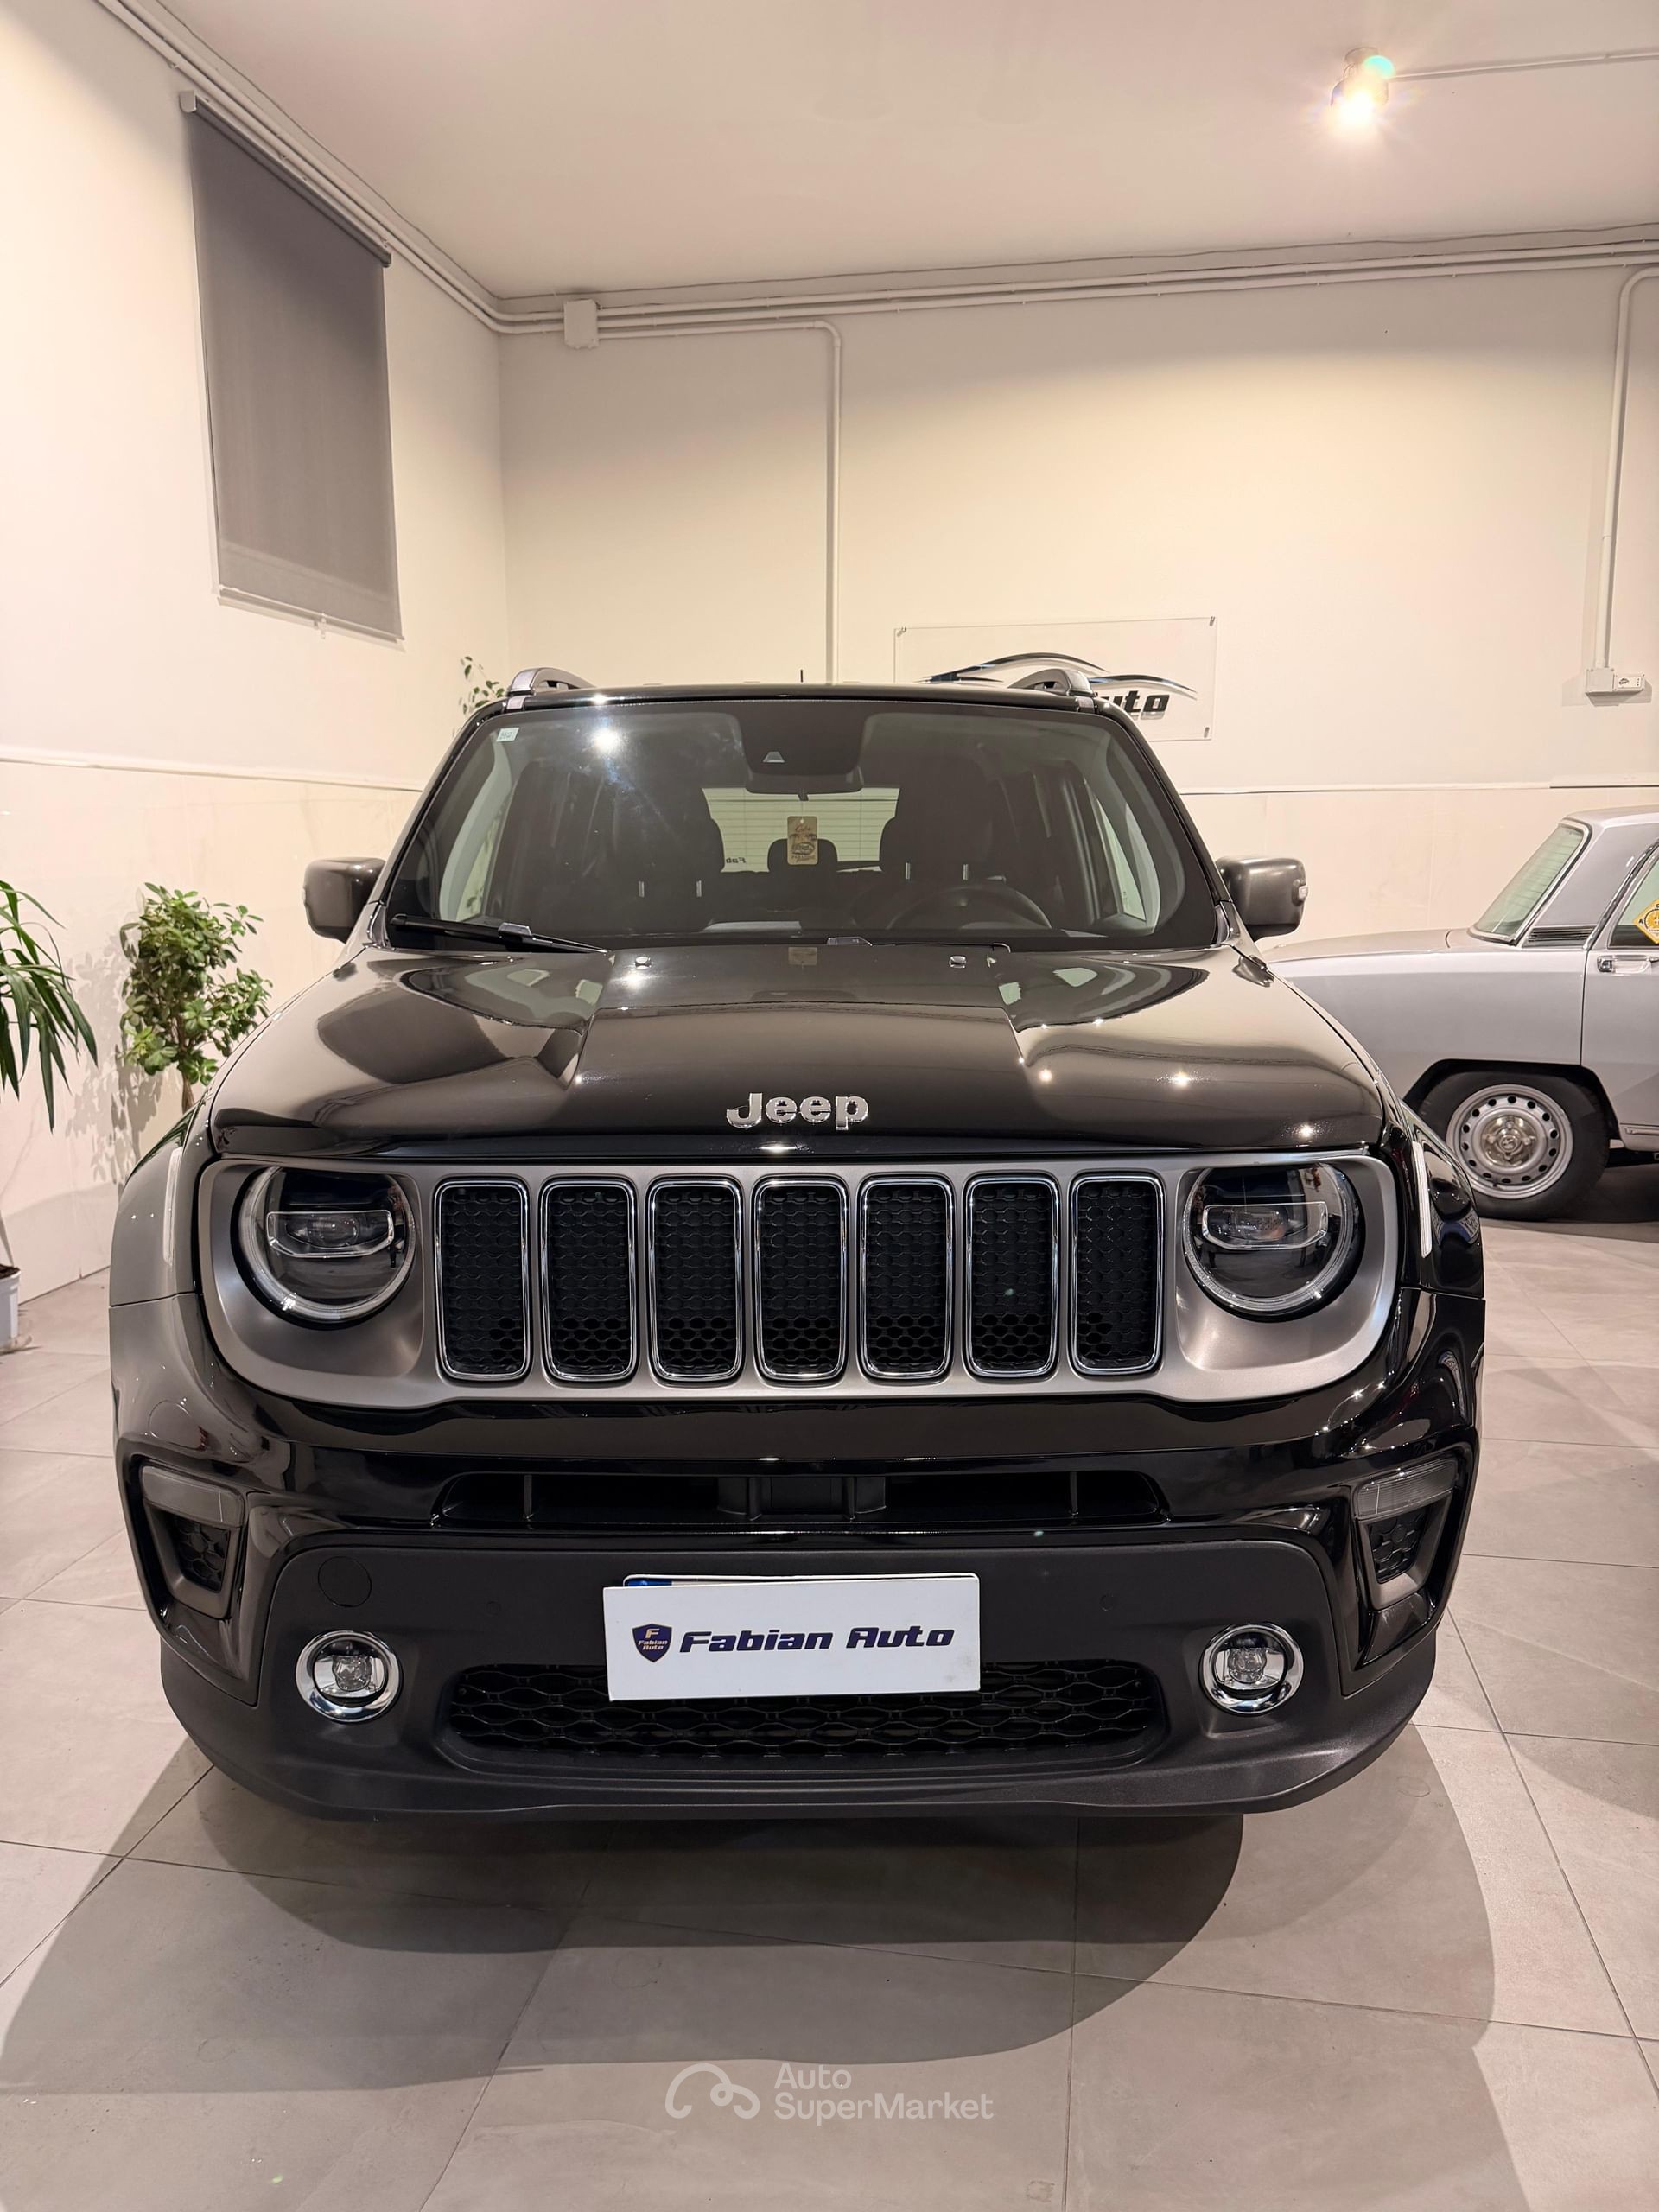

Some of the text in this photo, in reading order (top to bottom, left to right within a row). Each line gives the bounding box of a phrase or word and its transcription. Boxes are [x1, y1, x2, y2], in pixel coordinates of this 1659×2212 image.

[1095, 690, 1170, 712] to
[726, 1092, 869, 1130] Jeep
[645, 1628, 660, 1639] F
[679, 1625, 955, 1653] Fabian Auto
